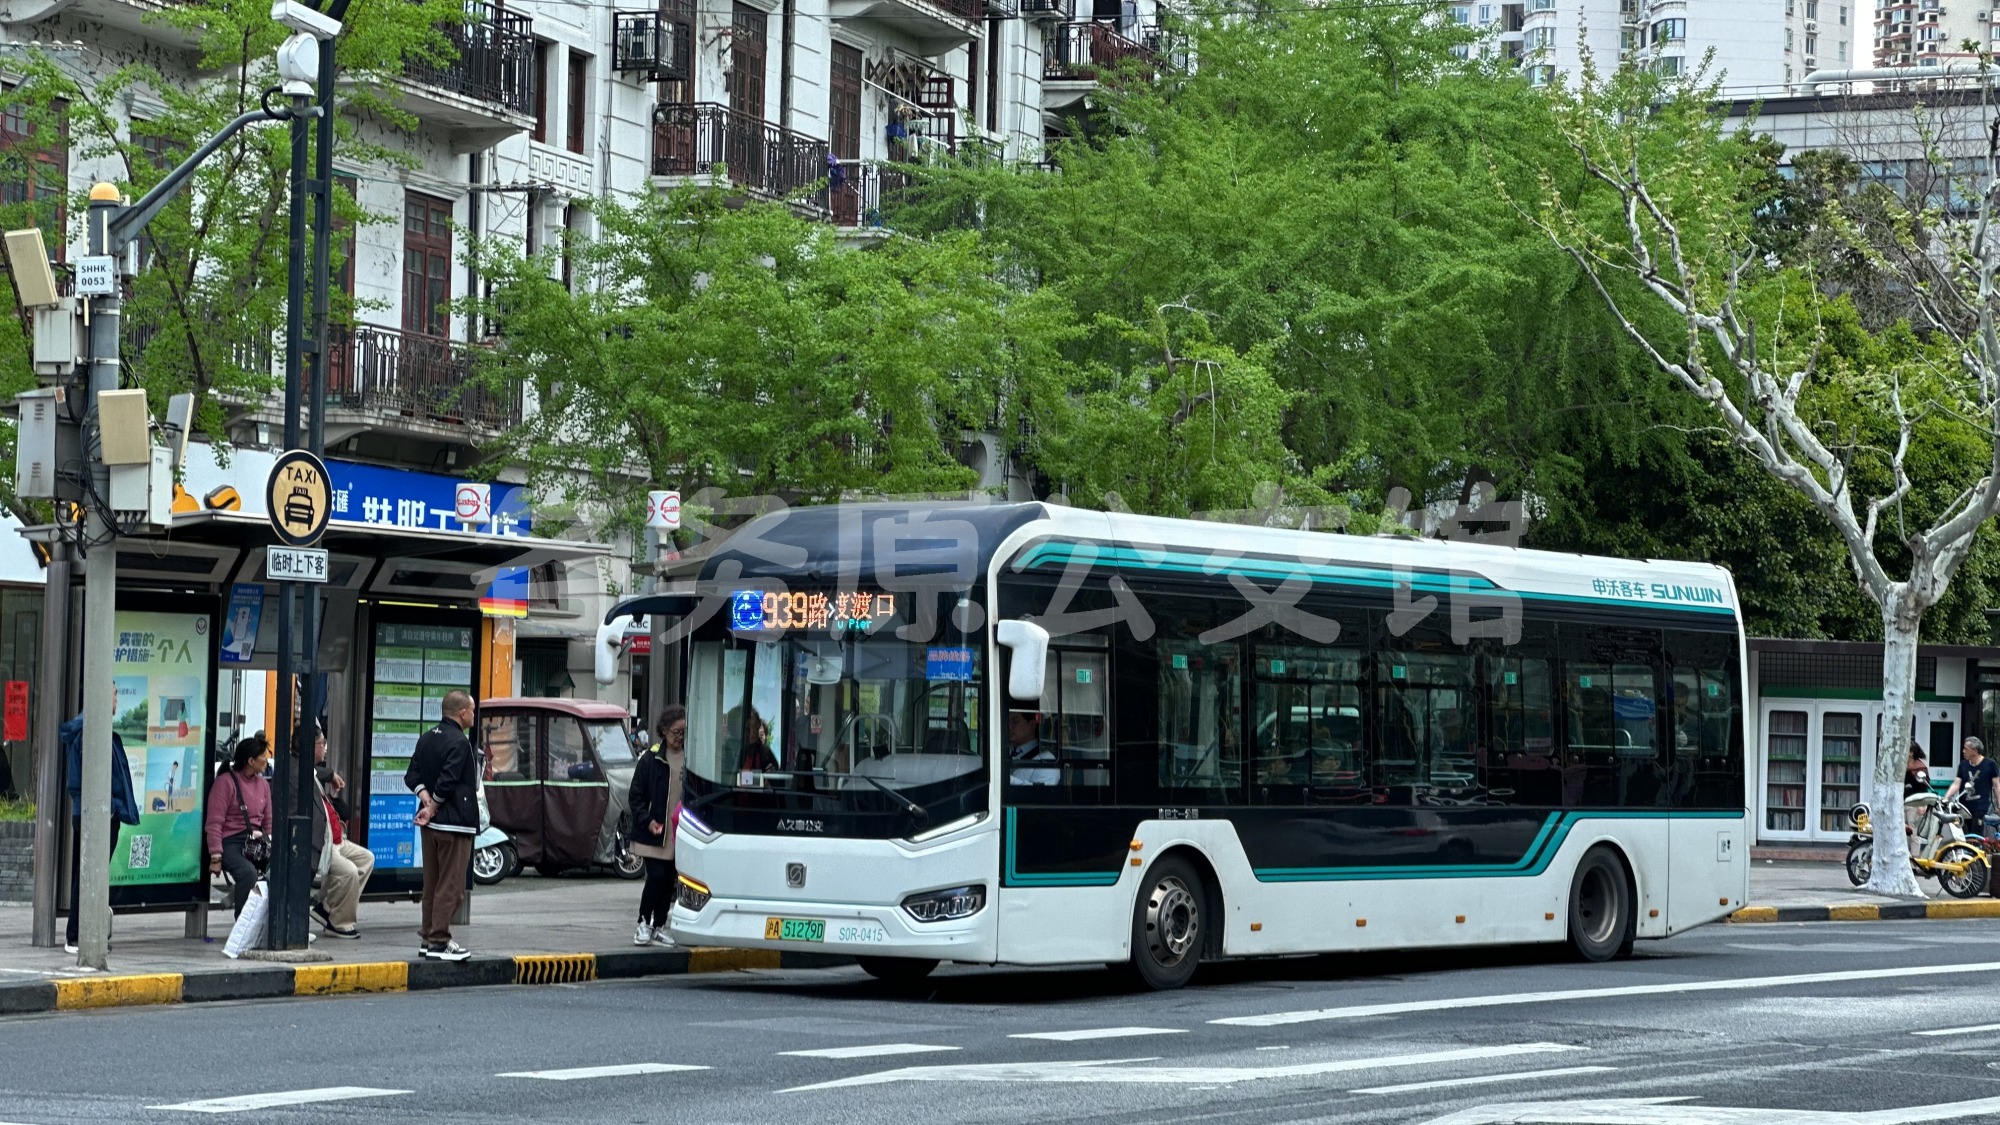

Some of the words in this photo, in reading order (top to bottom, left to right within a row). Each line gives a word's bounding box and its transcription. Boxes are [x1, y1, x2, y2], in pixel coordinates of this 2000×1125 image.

[81, 264, 106, 273] SHHK
[81, 277, 105, 286] 0053
[286, 466, 316, 484] TAXI
[295, 487, 307, 496] TAXI
[271, 552, 324, 575] 临时上下客
[1591, 578, 1647, 599] 申沃客车
[1651, 583, 1723, 603] SUNWIN
[762, 592, 828, 629] 939路
[628, 621, 649, 629] ICBC
[849, 618, 873, 629] Pier
[157, 639, 193, 664] 个人
